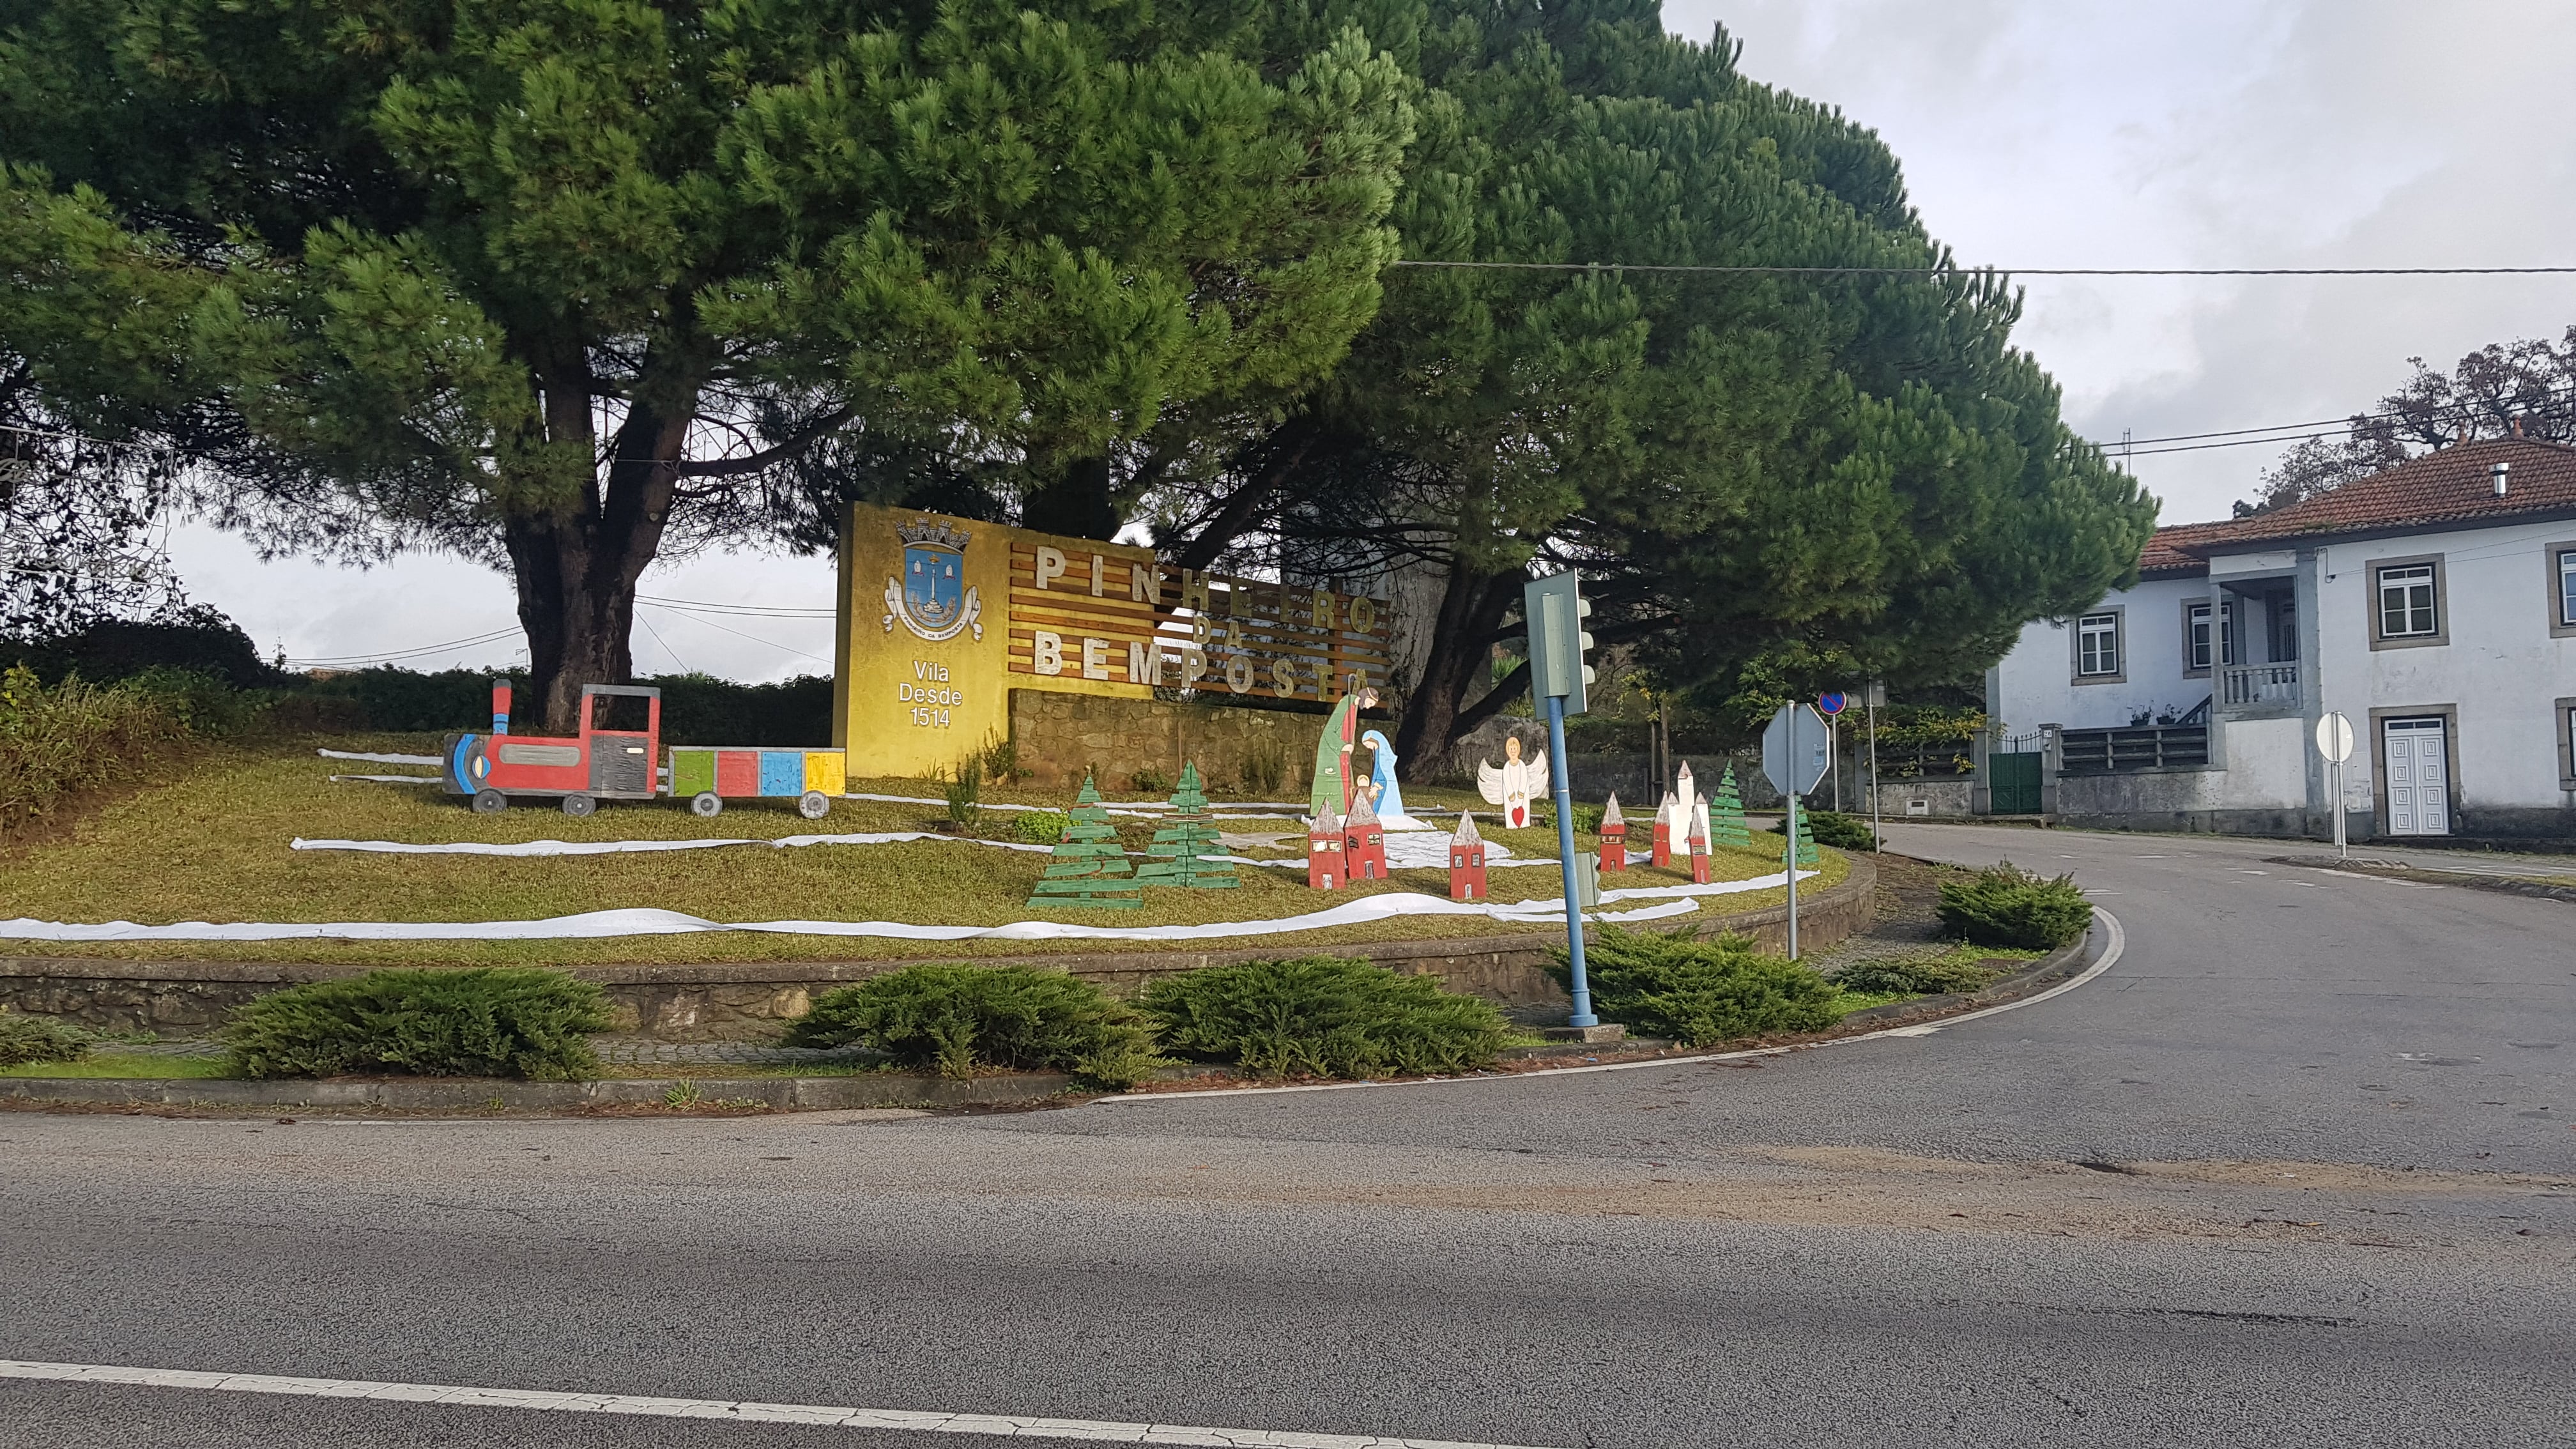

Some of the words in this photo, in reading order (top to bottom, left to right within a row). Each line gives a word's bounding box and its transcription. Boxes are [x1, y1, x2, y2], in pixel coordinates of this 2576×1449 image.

[1036, 545, 1374, 634] PINHEIRO
[1193, 615, 1243, 649] DA
[914, 661, 949, 682] Vila
[900, 683, 962, 705] Desde
[910, 707, 950, 727] 1514
